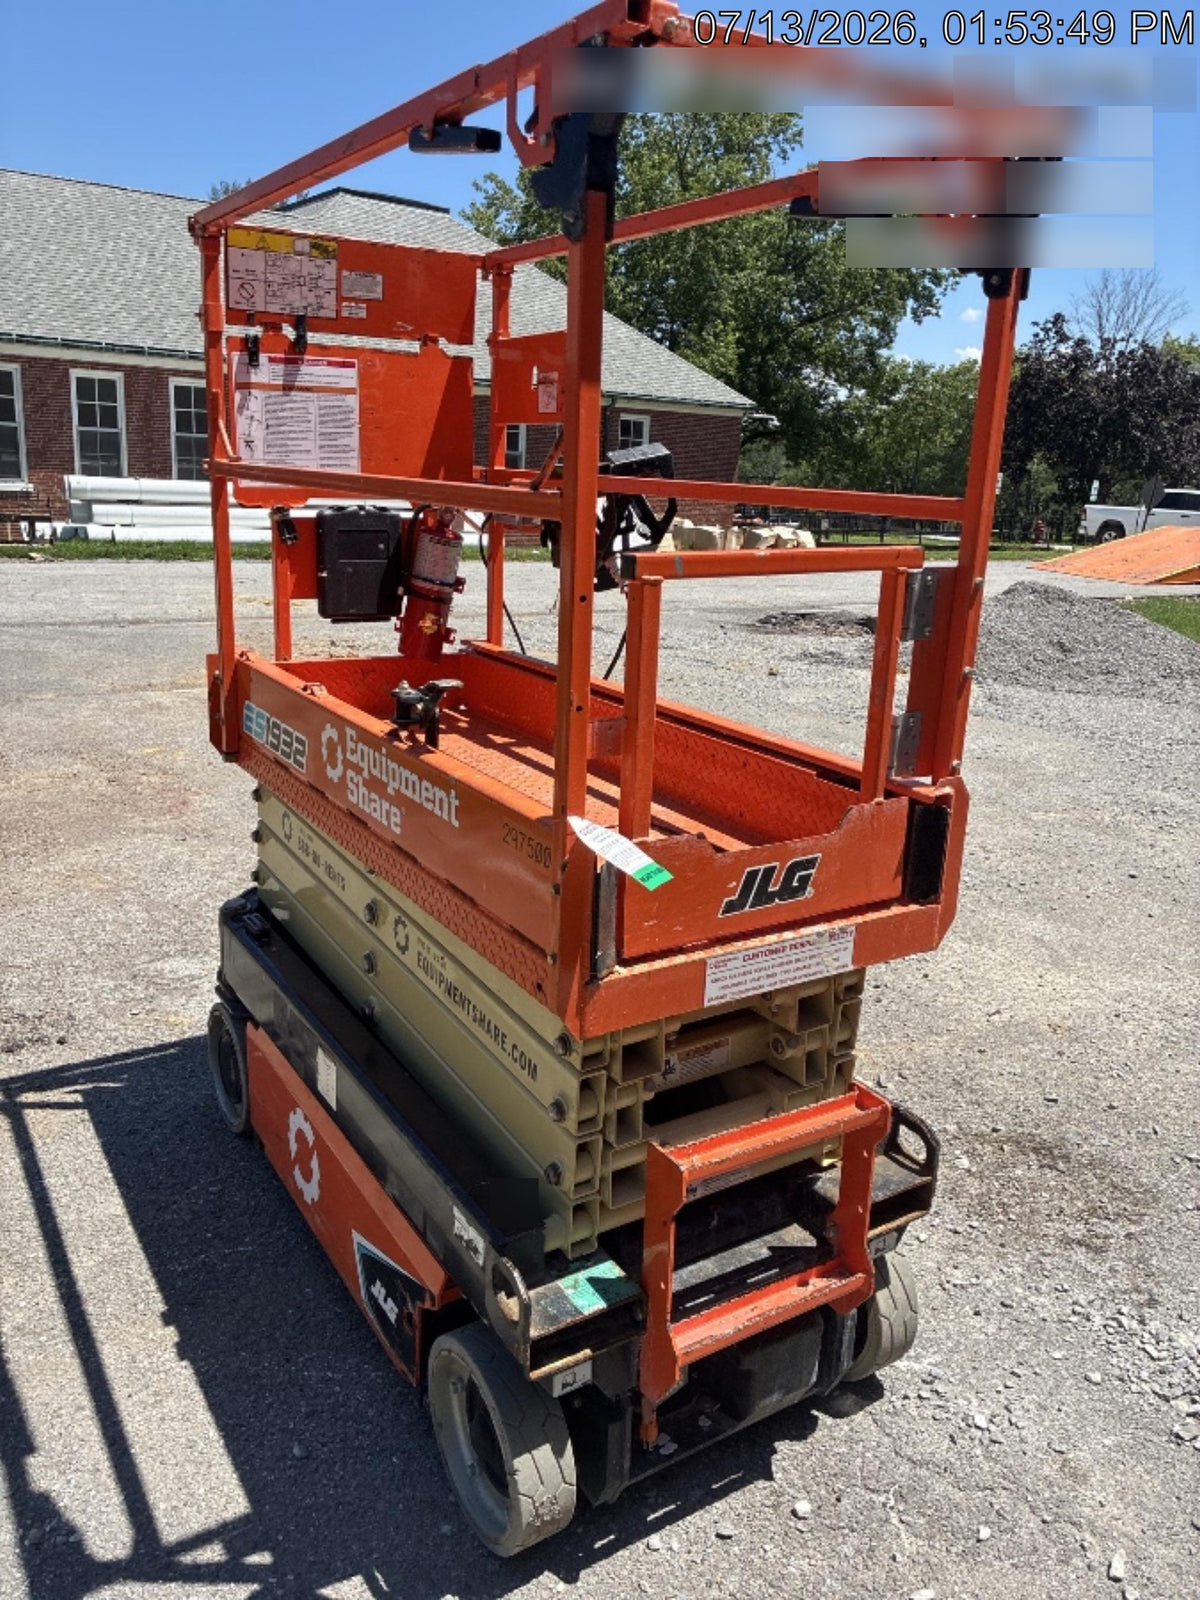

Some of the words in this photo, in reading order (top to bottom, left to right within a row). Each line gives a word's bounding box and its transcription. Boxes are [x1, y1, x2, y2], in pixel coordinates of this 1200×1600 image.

[243, 701, 308, 773] ES1932
[345, 726, 460, 828] Equipment
[346, 769, 401, 835] Share
[502, 822, 552, 869] 297500
[718, 853, 822, 918] JLG
[416, 950, 538, 1082] EQUIPMENTSHARE.COM
[370, 1279, 399, 1328] JLG
